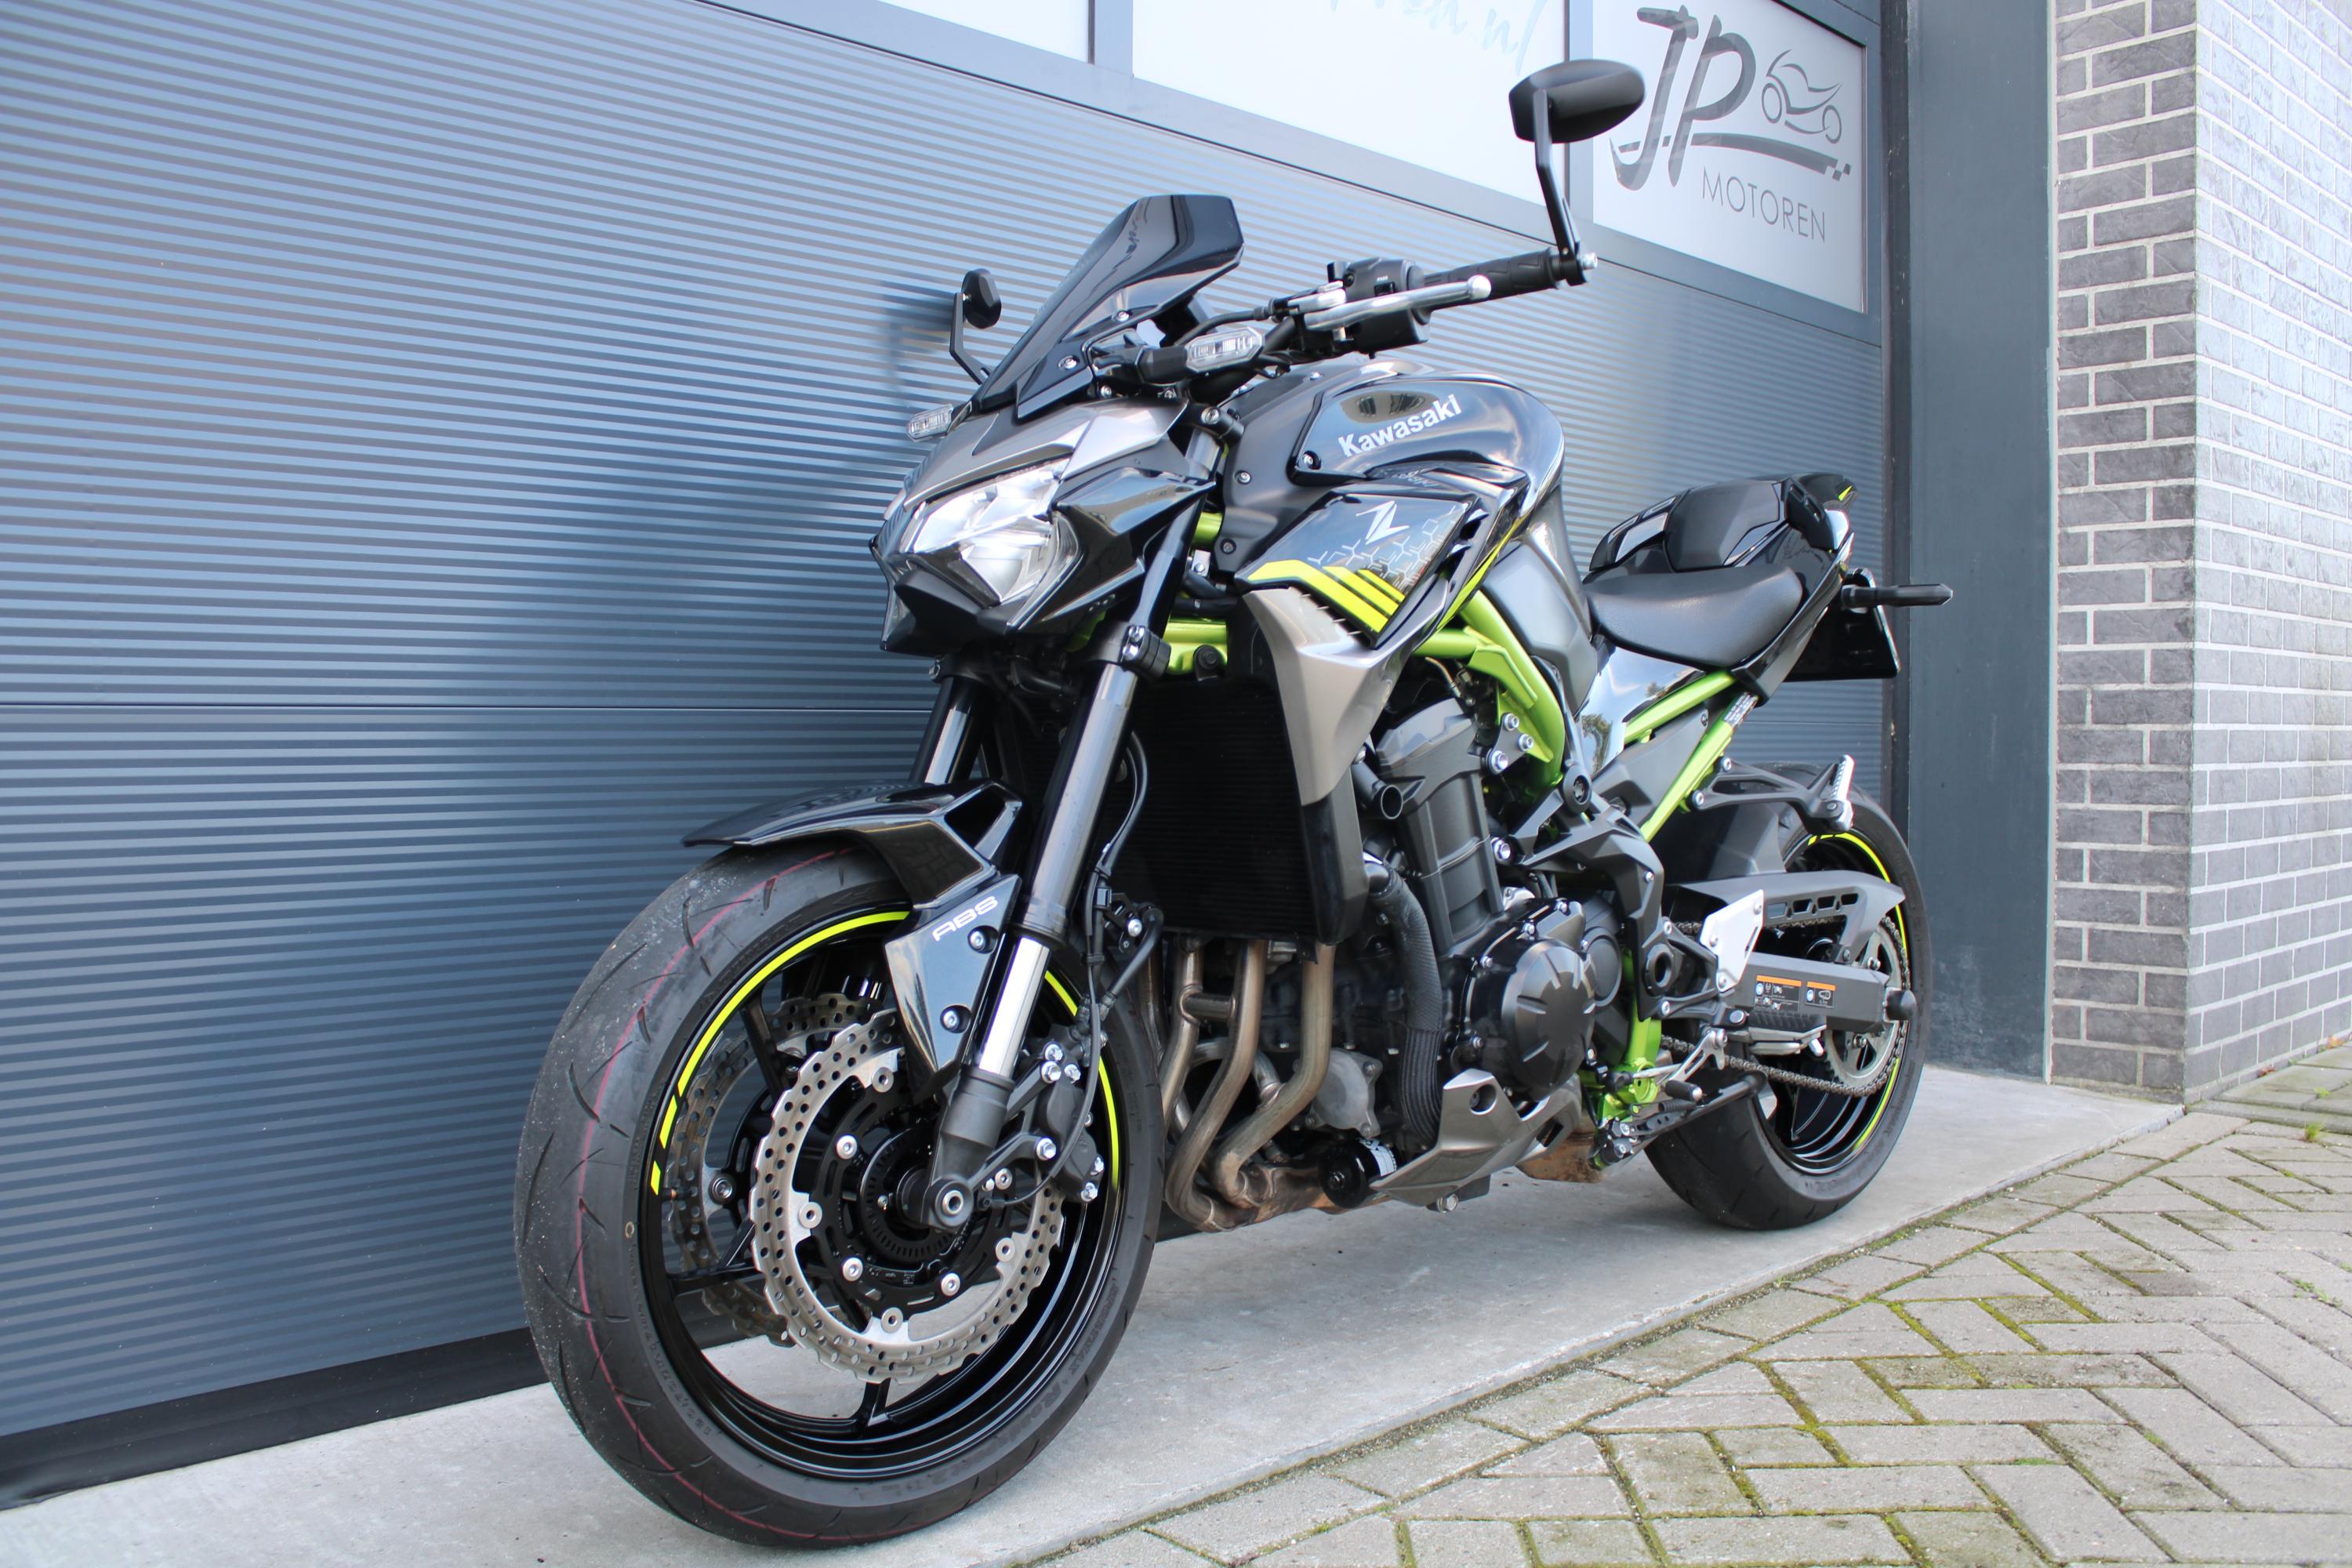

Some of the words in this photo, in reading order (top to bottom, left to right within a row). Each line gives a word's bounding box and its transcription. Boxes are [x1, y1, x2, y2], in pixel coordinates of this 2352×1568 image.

[1702, 166, 1825, 243] MOTOREN
[1338, 394, 1462, 457] Kawasaki
[931, 896, 998, 941] ABS
